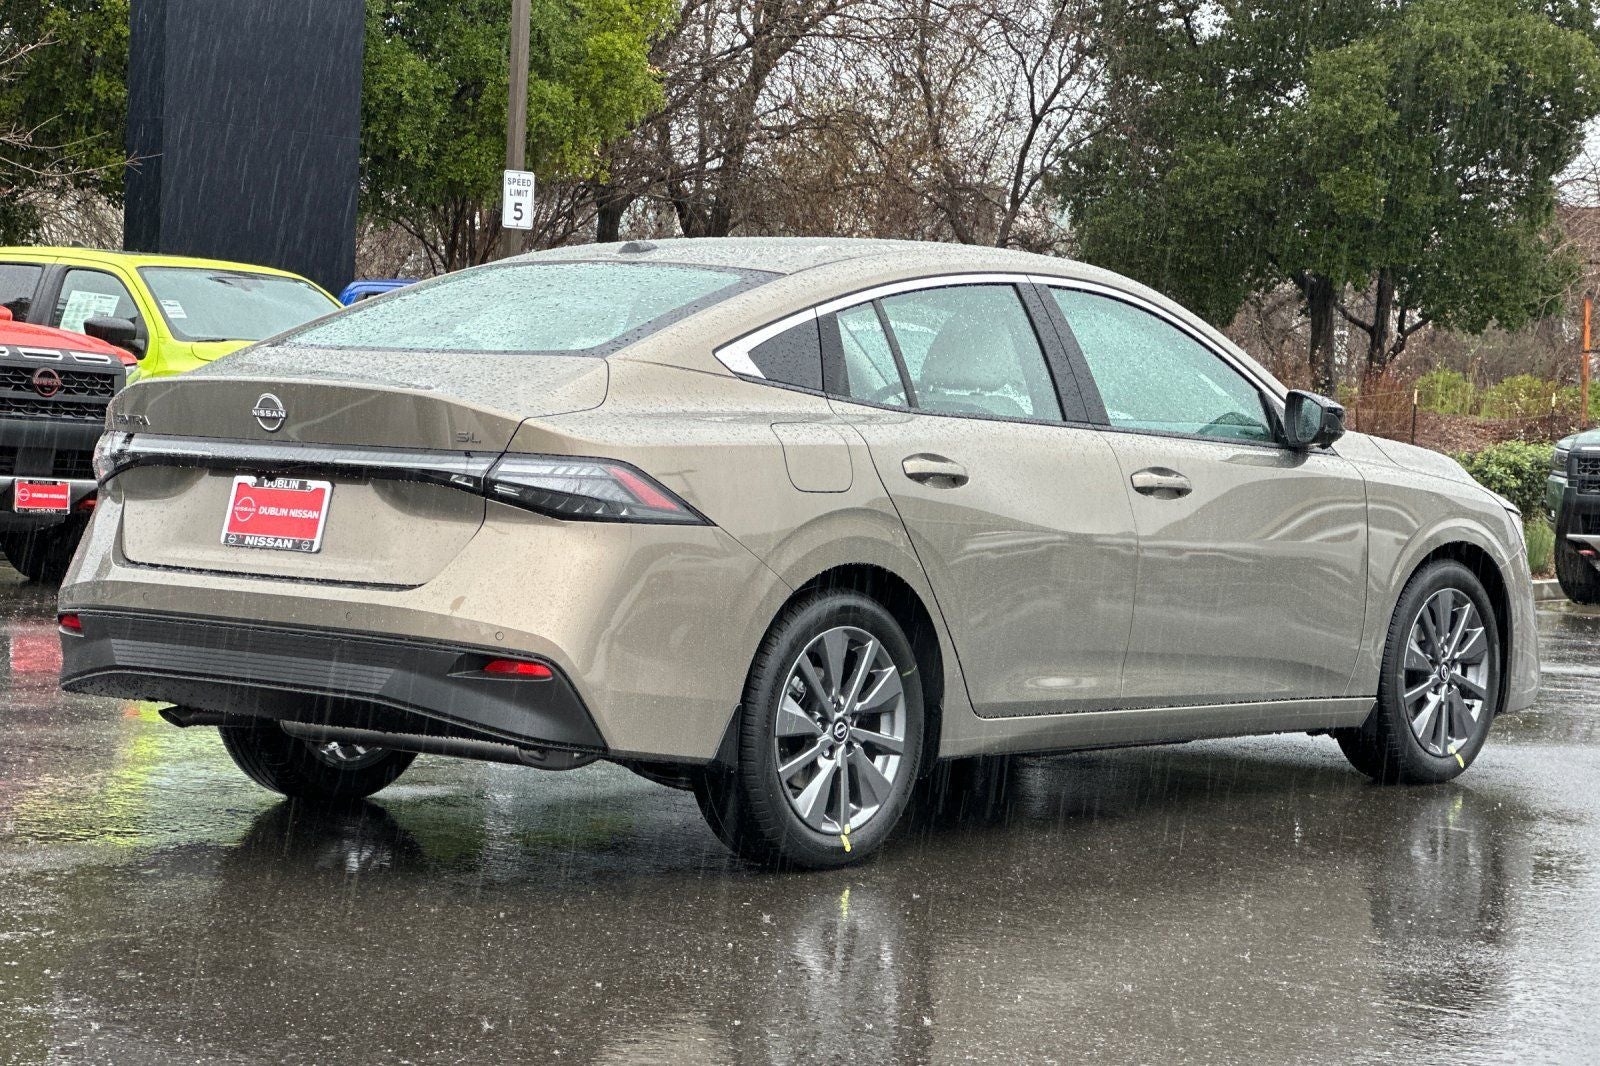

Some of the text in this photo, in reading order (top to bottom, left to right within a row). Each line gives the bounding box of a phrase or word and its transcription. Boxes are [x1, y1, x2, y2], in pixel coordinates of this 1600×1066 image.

[508, 178, 531, 187] SPEED
[510, 189, 528, 197] LIMIT
[513, 202, 524, 220] 5
[252, 408, 286, 418] NISSAN
[456, 432, 482, 444] SL
[263, 480, 299, 490] DUBLIN
[258, 506, 320, 520] DUBLIN NISSAN
[244, 536, 293, 548] NISSAN
